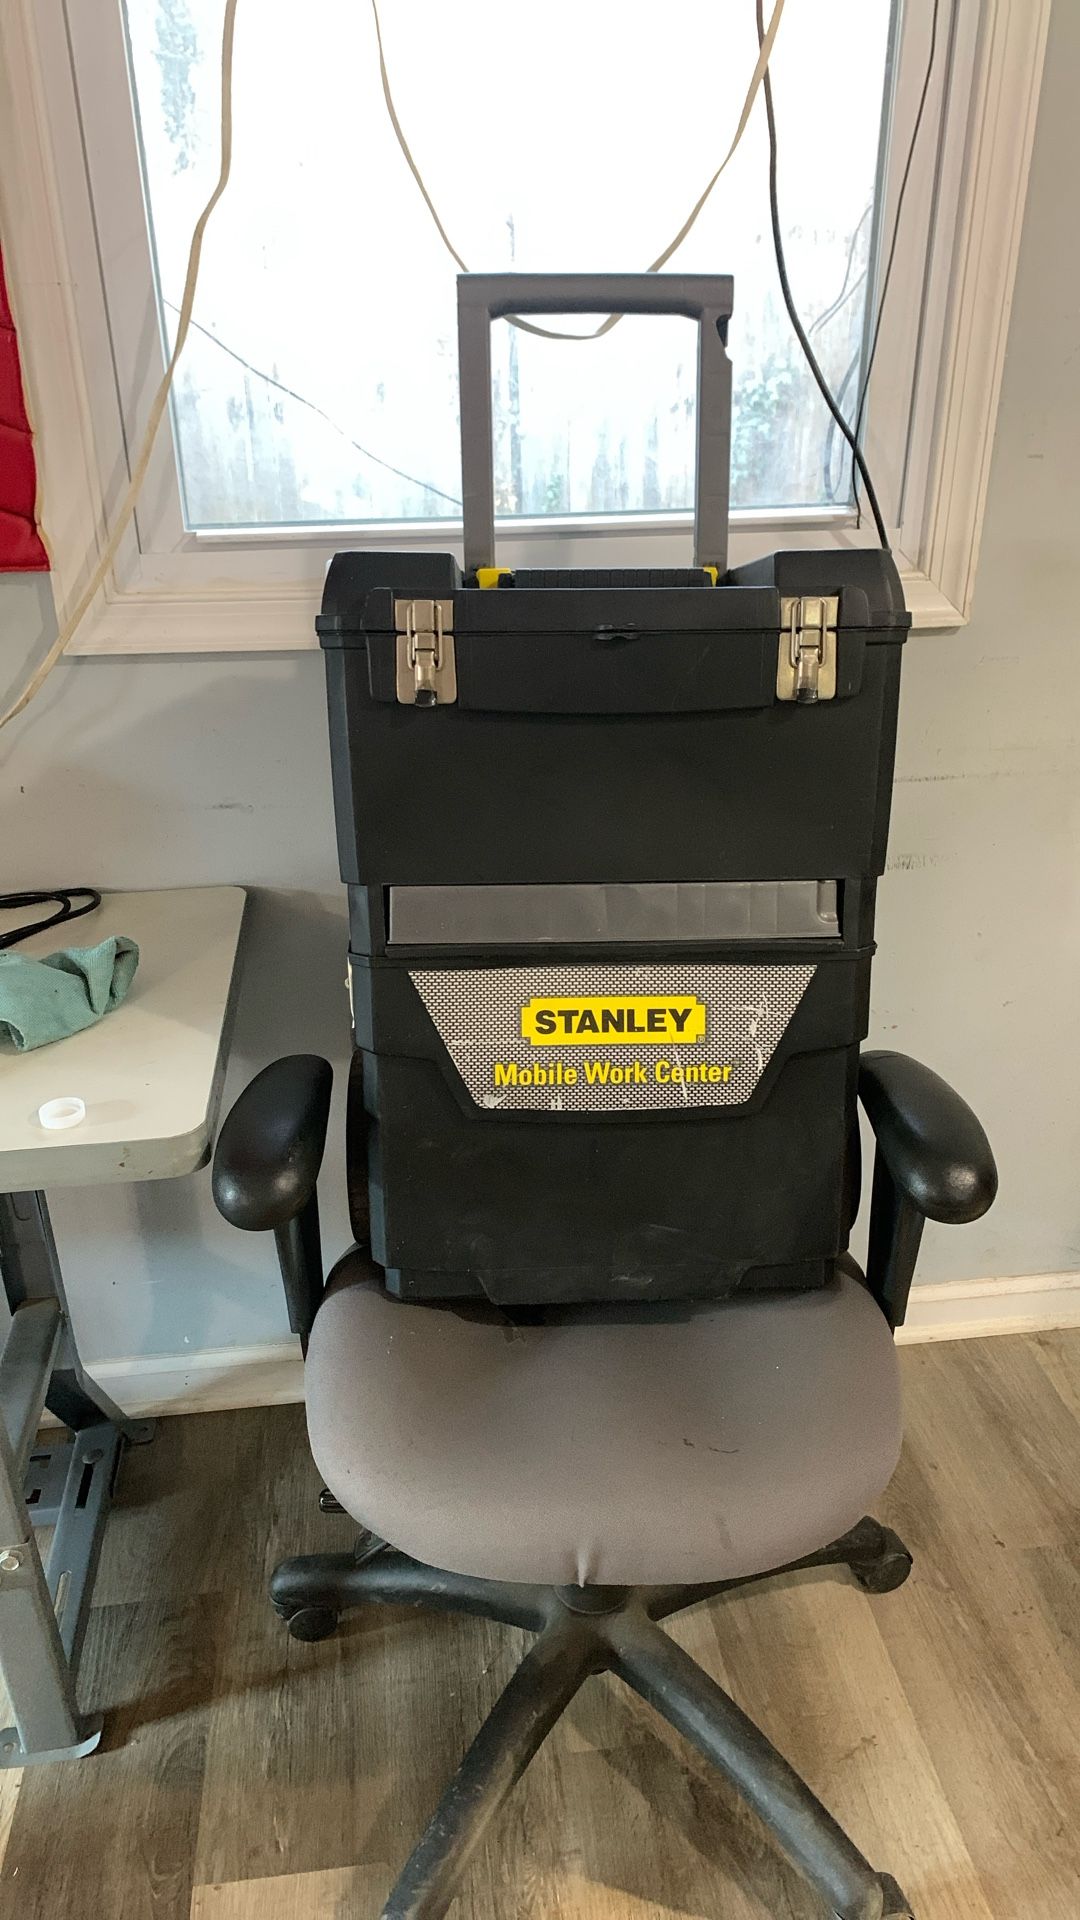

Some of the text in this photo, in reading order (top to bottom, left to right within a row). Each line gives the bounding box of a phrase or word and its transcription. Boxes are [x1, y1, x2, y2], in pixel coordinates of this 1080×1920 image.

[535, 1008, 693, 1034] STANLEY
[494, 1060, 732, 1087] Mobile Work Center
